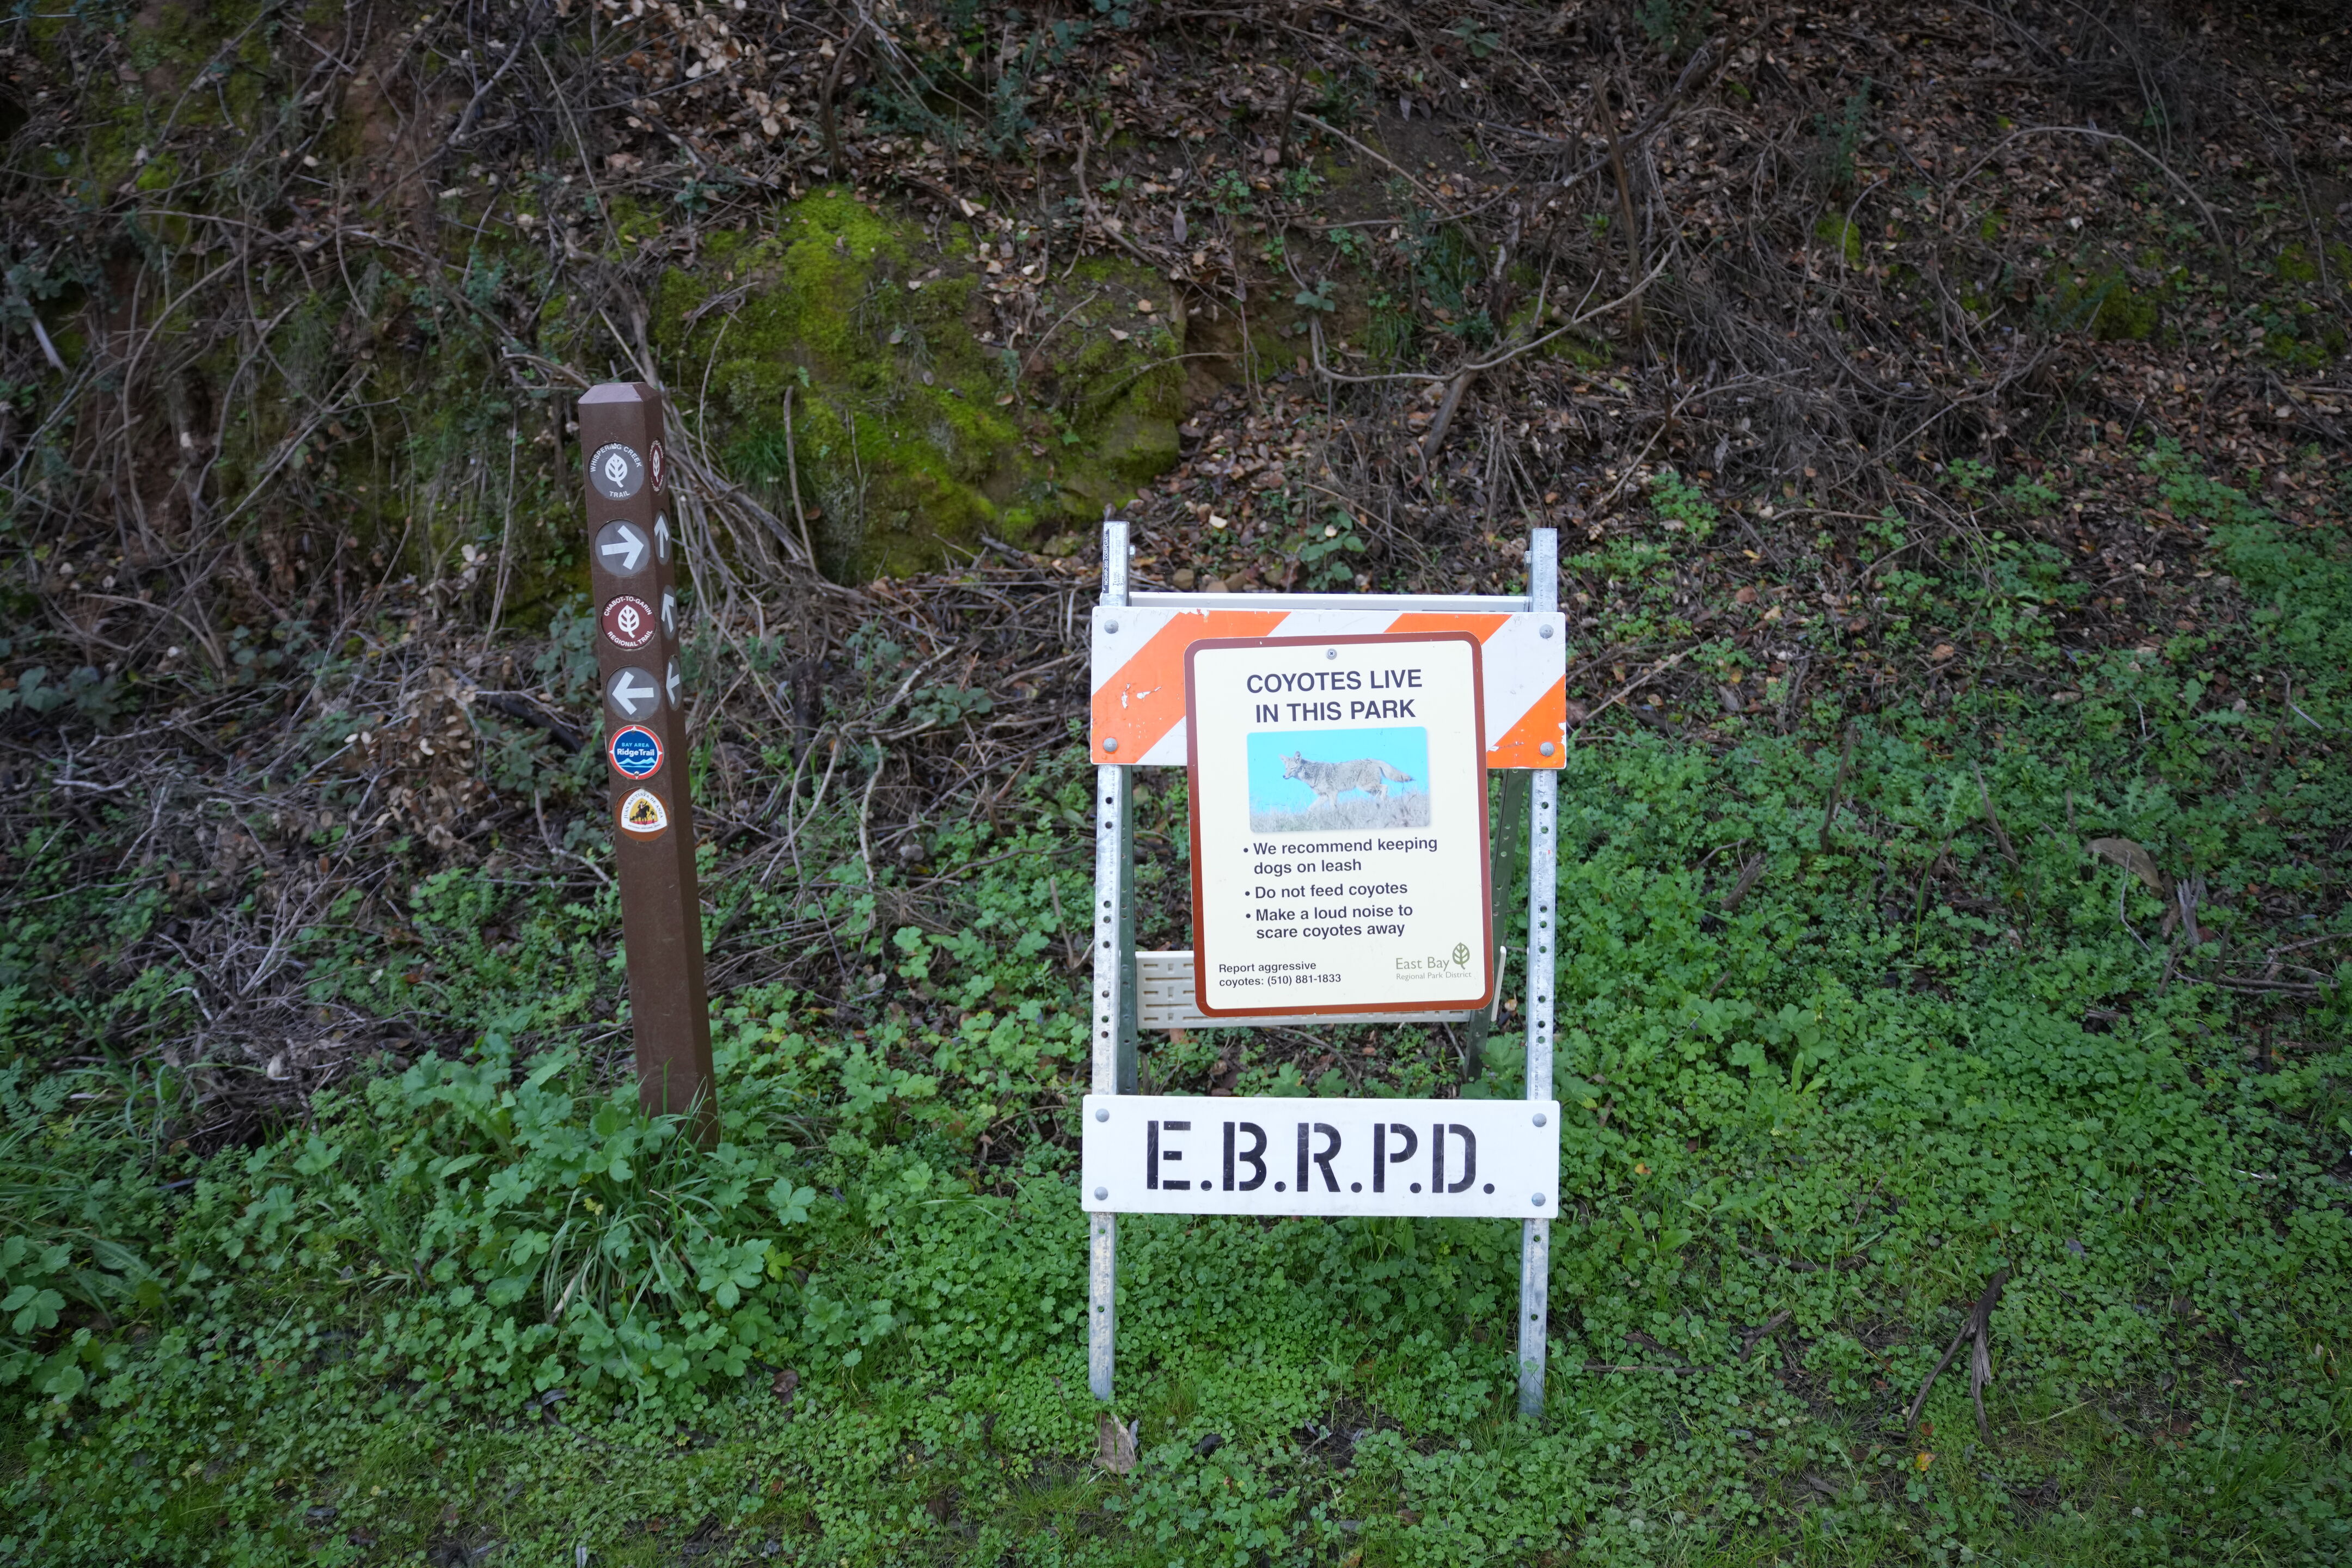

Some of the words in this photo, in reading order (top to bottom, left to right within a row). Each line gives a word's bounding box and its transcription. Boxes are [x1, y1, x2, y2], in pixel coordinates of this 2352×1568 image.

[624, 446, 642, 468] CREEK
[604, 596, 652, 616] CHABOT-TO-GARIN
[608, 631, 638, 647] REGIONAL
[638, 630, 653, 644] TRAIL
[1247, 670, 1362, 693] COYOTES
[1370, 669, 1422, 689] LIVE
[1256, 704, 1278, 723] IN
[1286, 701, 1342, 721] THIS
[1351, 699, 1416, 719] PARK
[1253, 843, 1276, 855] We
[1282, 839, 1373, 854] recommend
[1377, 837, 1437, 853] keeping
[1254, 862, 1292, 877] dogs
[1297, 862, 1315, 873] on
[1321, 859, 1362, 872] leash
[1255, 886, 1276, 898] Do
[1282, 886, 1306, 898] not
[1310, 884, 1343, 897] feed
[1349, 882, 1408, 898] coyotes
[1256, 908, 1295, 921] Make
[1300, 910, 1309, 920] a
[1314, 906, 1347, 919] loud
[1352, 905, 1393, 917] noise
[1398, 904, 1413, 916] to
[1256, 928, 1297, 939] scare
[1303, 924, 1362, 940] coyotes
[1367, 924, 1405, 936] away
[1219, 964, 1254, 974] Report
[1258, 961, 1316, 973] aggressive
[1396, 958, 1422, 970] East
[1428, 957, 1449, 971] Bay
[1219, 977, 1264, 988] coyotes:
[1267, 975, 1292, 987] (510)
[1295, 973, 1342, 983] 881-1833
[1396, 973, 1425, 981] Regional
[1147, 1120, 1496, 1193] E.B.R.P.D.
